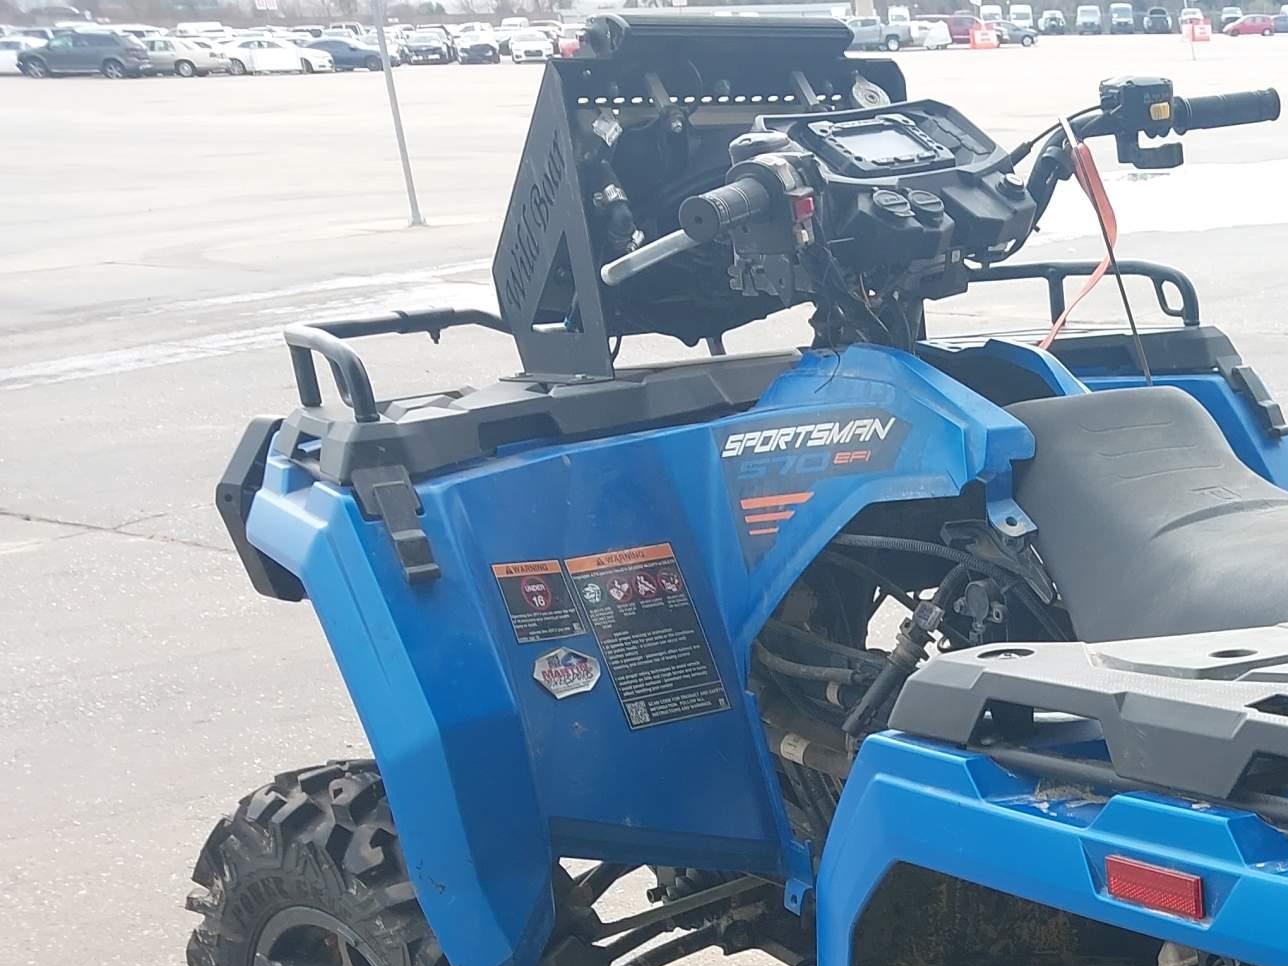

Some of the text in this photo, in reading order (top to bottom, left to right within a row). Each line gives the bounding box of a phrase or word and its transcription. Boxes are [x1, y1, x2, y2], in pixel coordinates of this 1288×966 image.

[721, 417, 897, 458] SPORTSMAN
[738, 450, 872, 480] 570 EFI
[532, 595, 546, 608] 16
